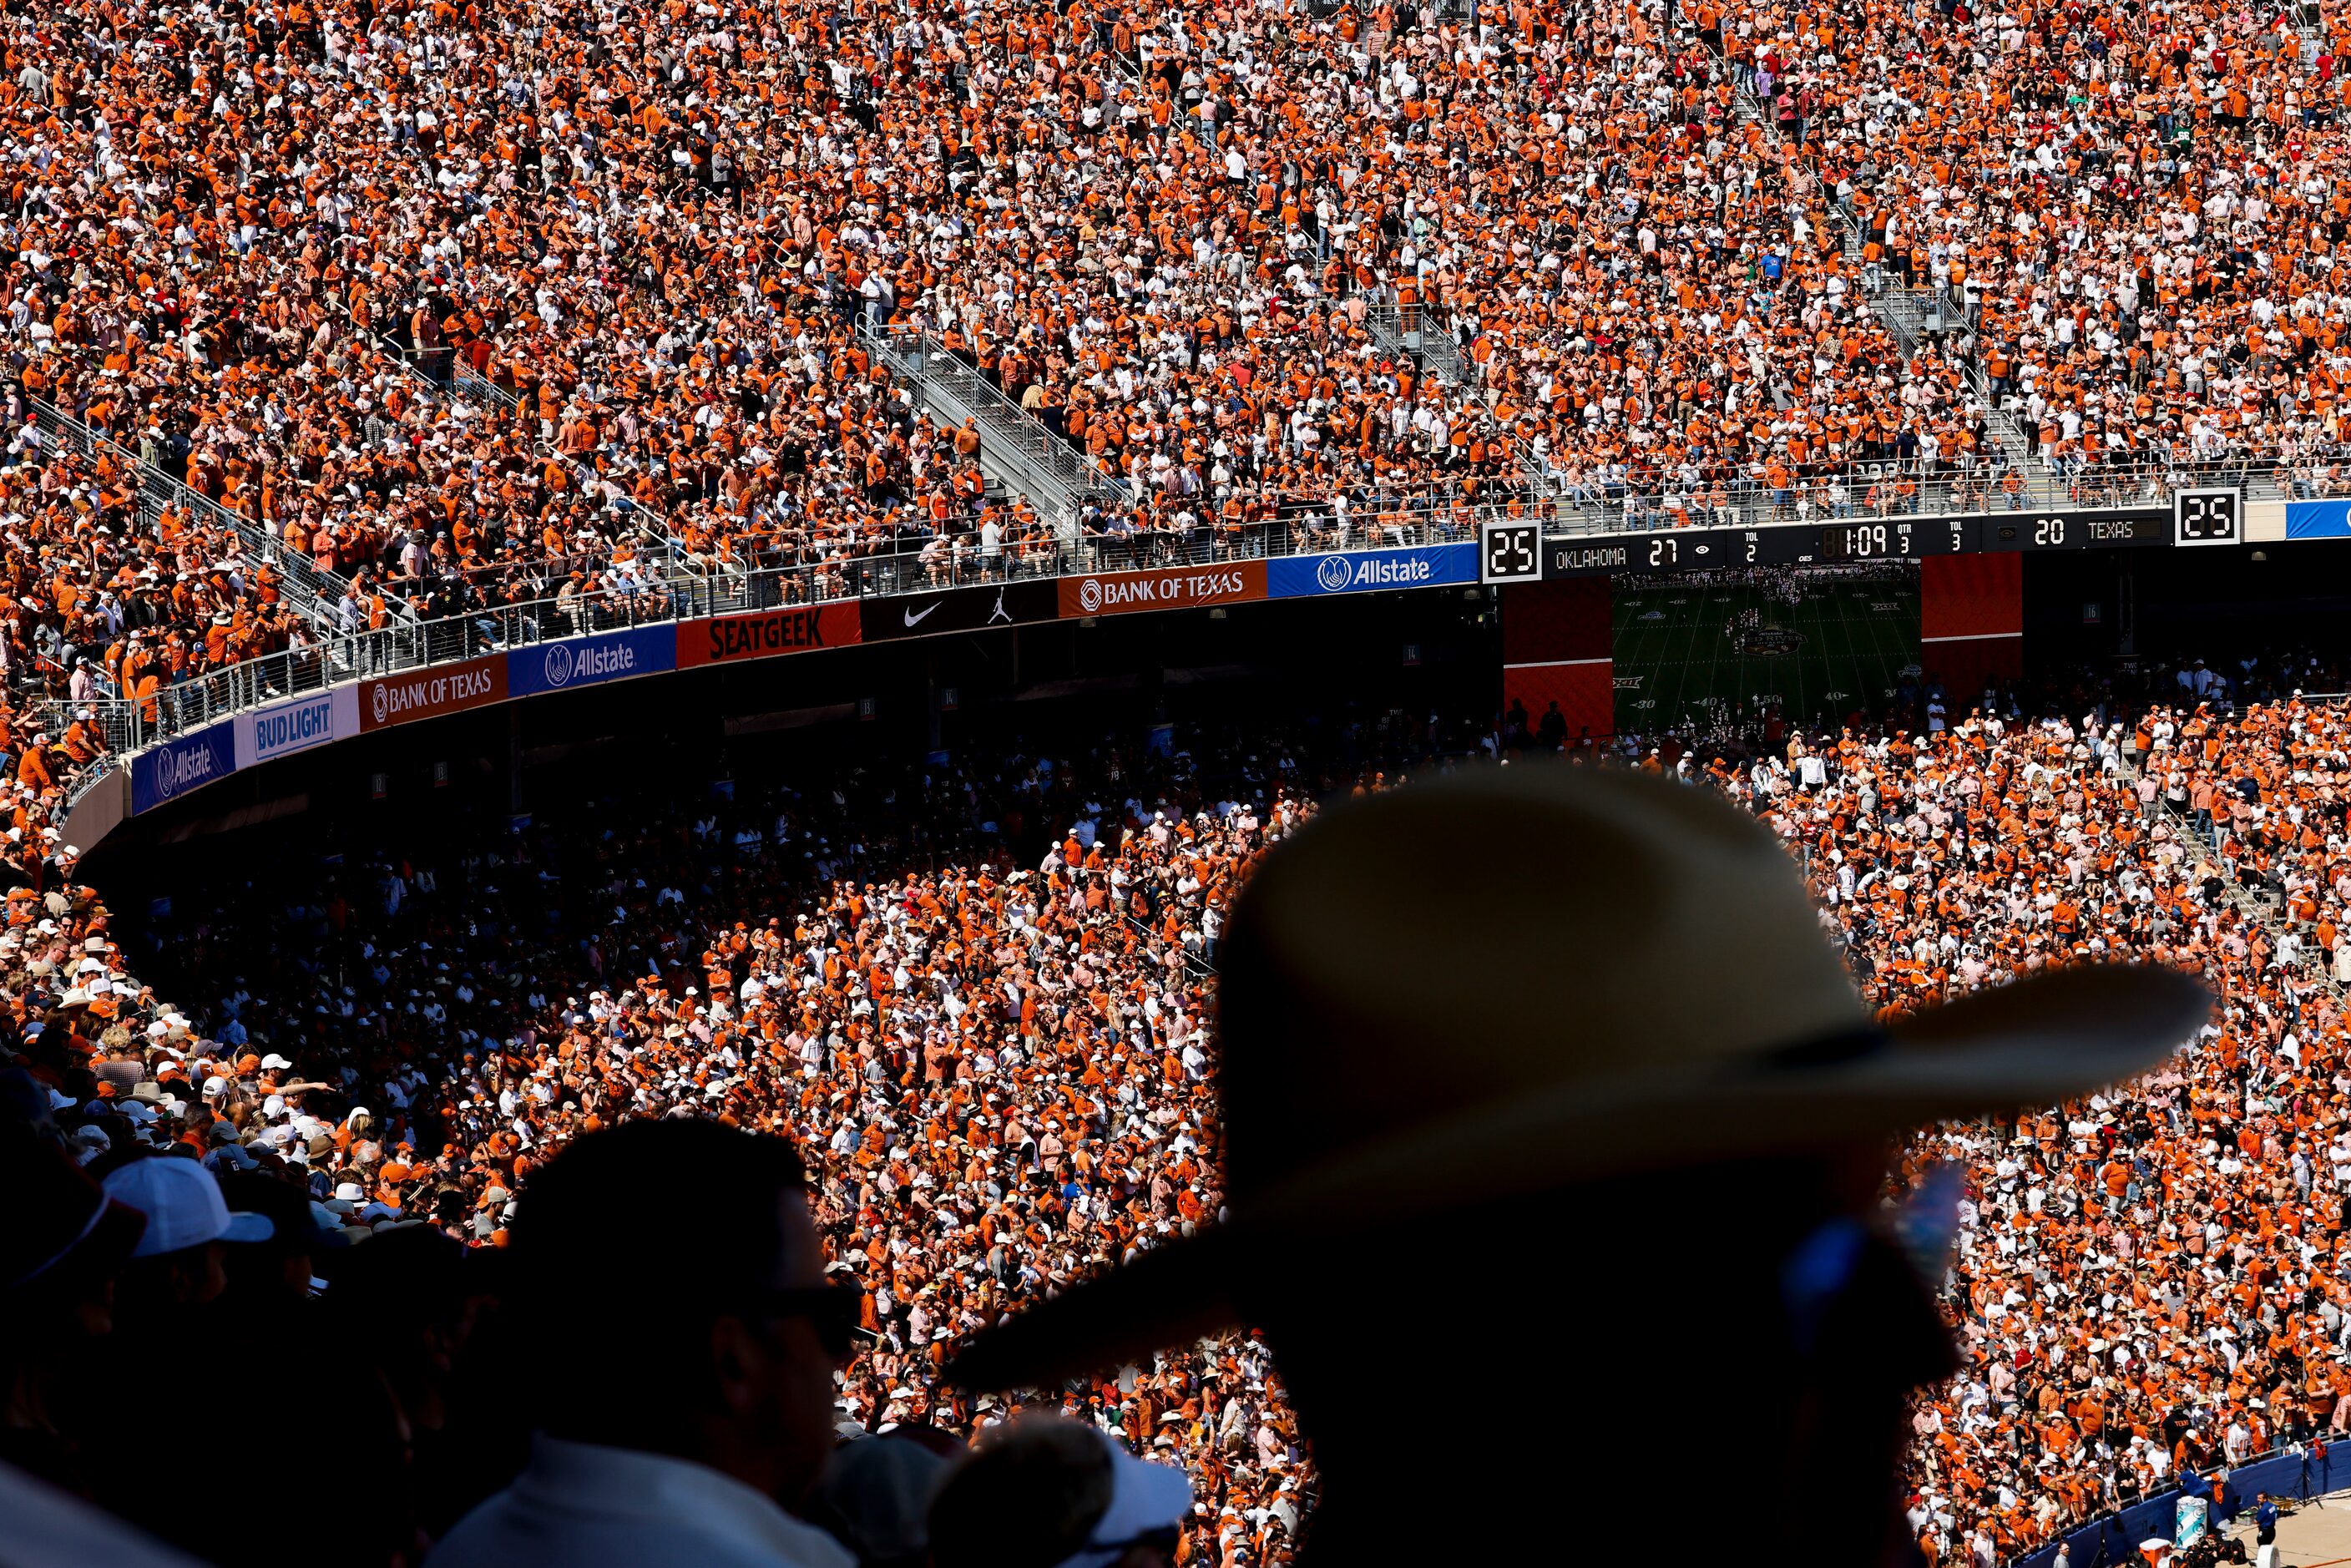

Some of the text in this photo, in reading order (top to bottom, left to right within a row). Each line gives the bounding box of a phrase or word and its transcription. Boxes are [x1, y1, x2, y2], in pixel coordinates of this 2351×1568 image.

[1949, 521, 1963, 532] TOL
[2184, 497, 2231, 537] 25
[1745, 532, 1759, 542] TOL
[1846, 525, 1887, 556] 1:09
[1897, 524, 1912, 535] QTR
[2035, 518, 2065, 545] 20
[2088, 521, 2134, 539] TEXAS
[1491, 530, 1533, 574] 25
[1649, 539, 1677, 566] 27
[1746, 544, 1757, 562] 2
[1899, 536, 1909, 554] 3
[1951, 534, 1961, 551] 3
[1556, 547, 1626, 569] OKLAHOMA
[1352, 557, 1430, 585] Allstate
[1105, 571, 1243, 604] BANK OF TEXAS
[2088, 607, 2096, 619] 16
[710, 607, 826, 660] SEATGEEK
[573, 643, 634, 678] Allstate
[1408, 648, 1416, 661] 14
[389, 668, 492, 714] BANK OF TEXAS
[946, 691, 953, 705] 14
[1637, 699, 1656, 709] 30
[257, 703, 330, 751] BUD LIGHT
[174, 743, 210, 784] Allstate
